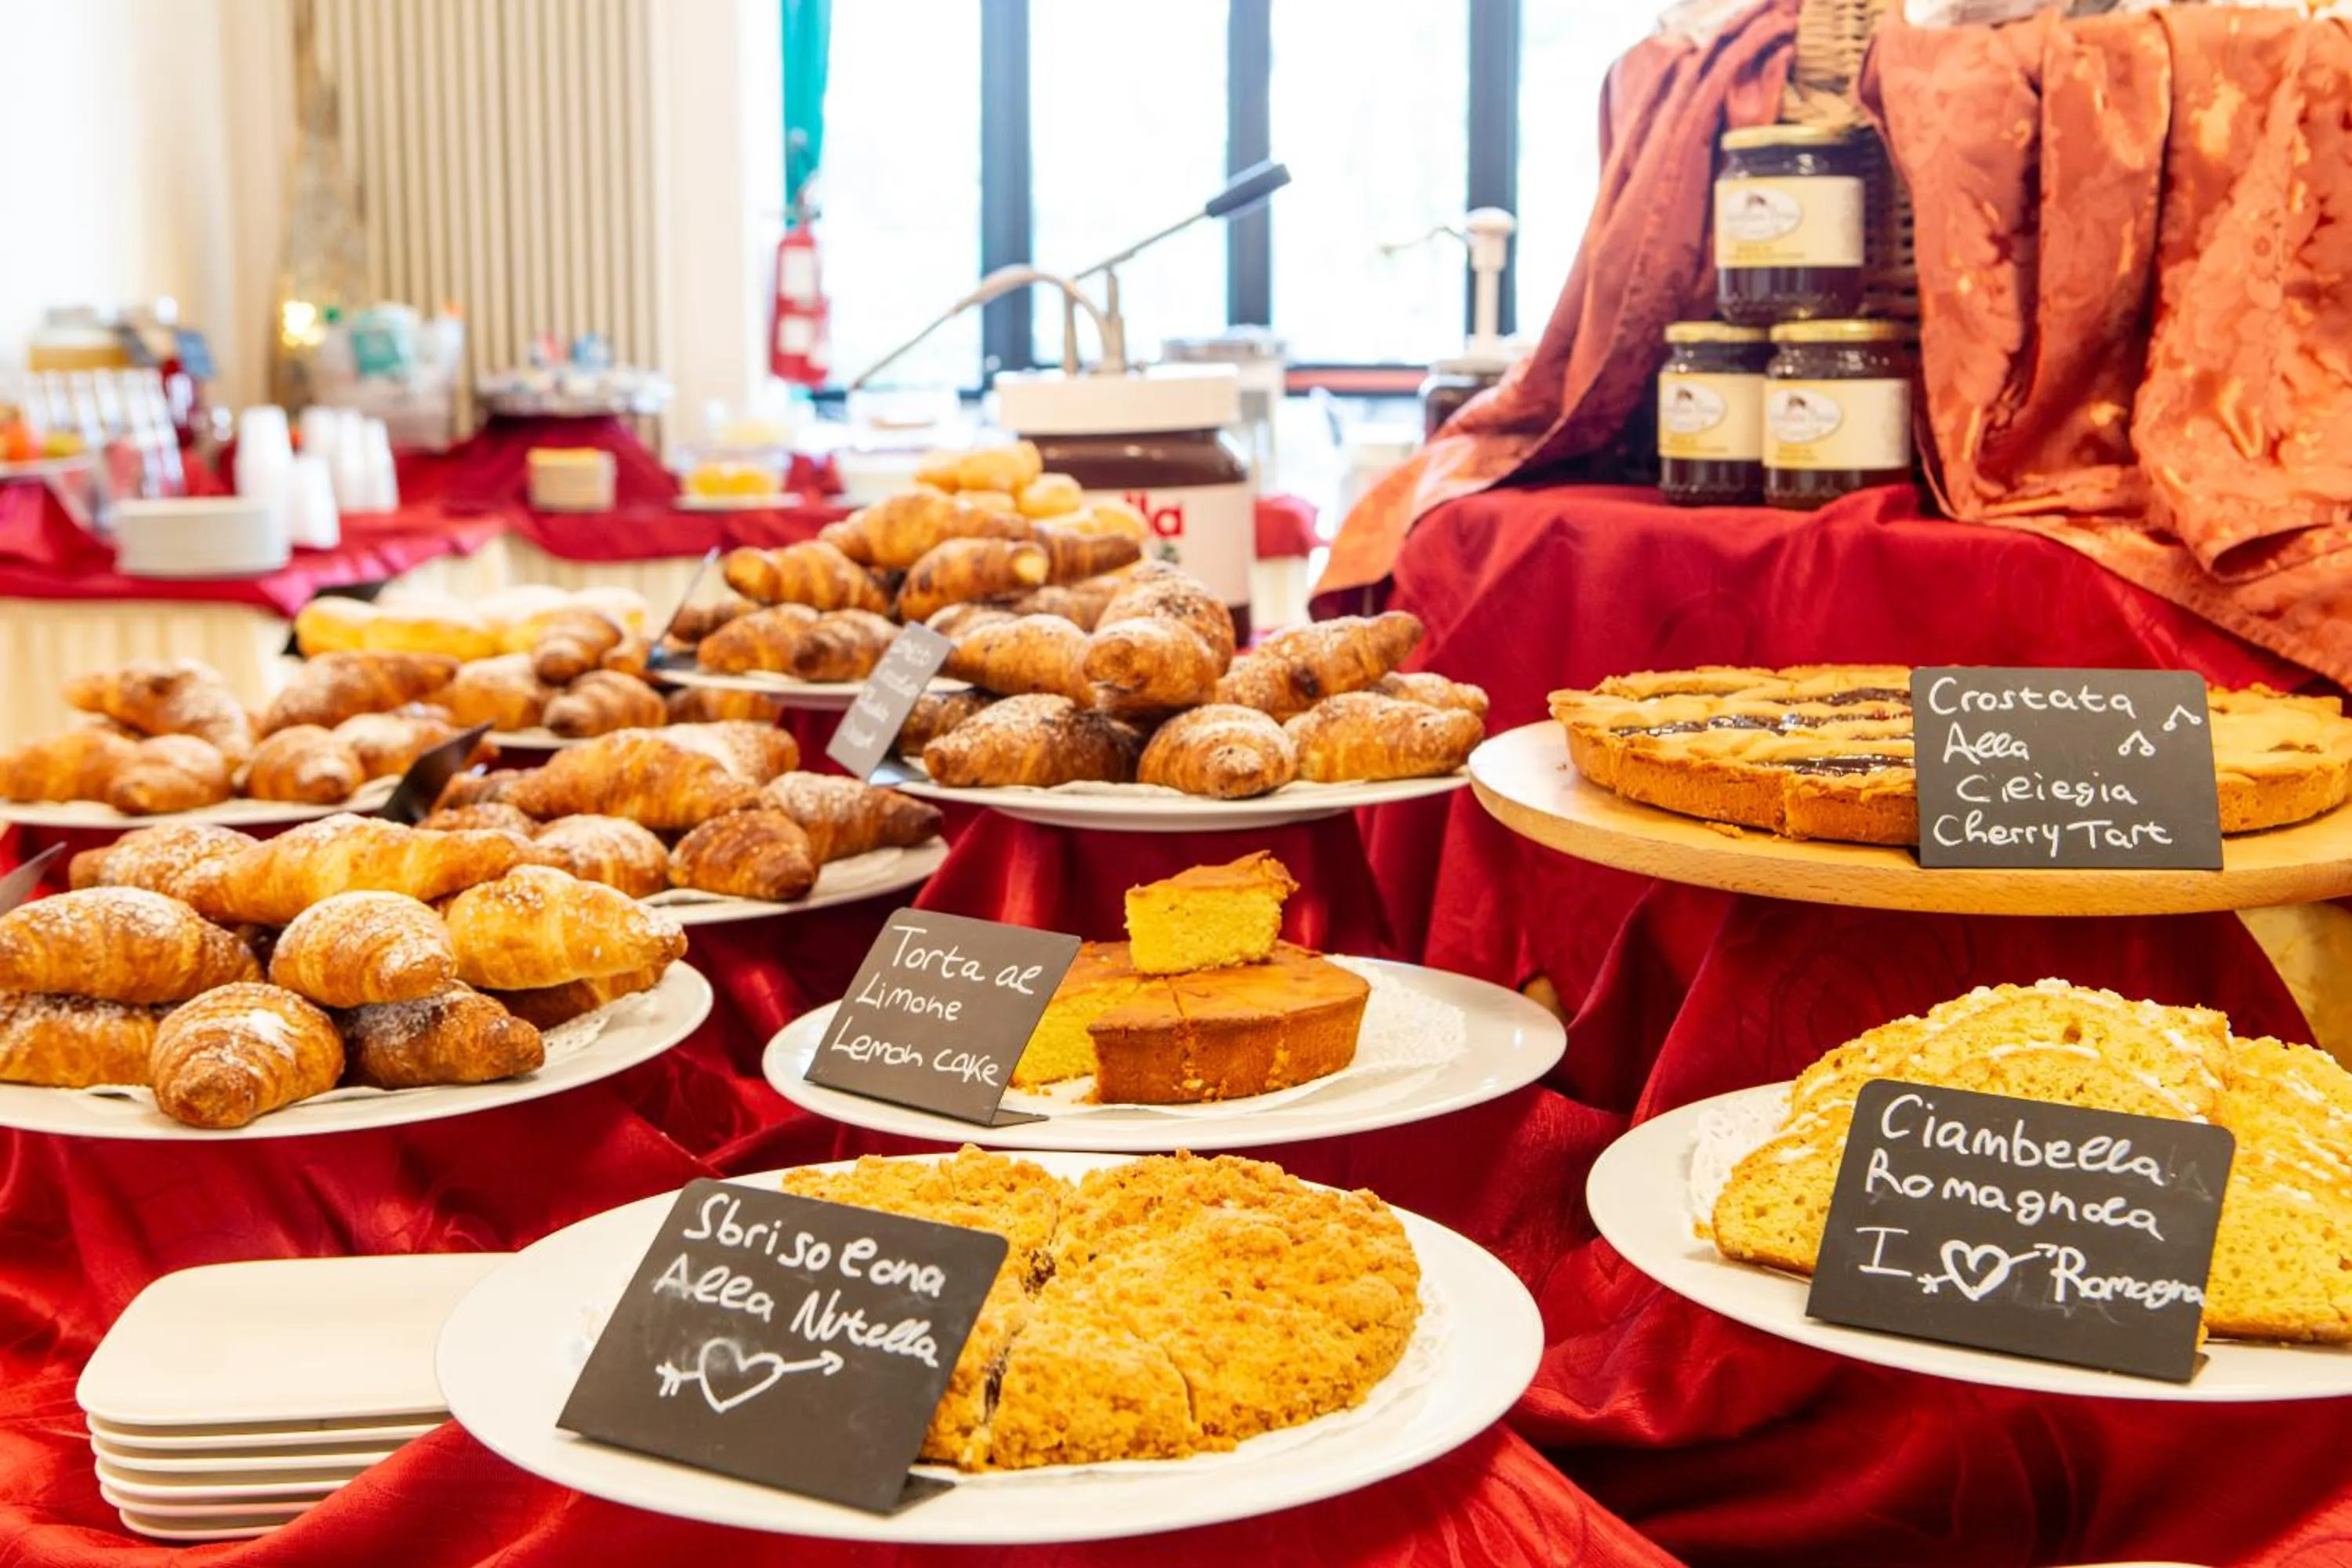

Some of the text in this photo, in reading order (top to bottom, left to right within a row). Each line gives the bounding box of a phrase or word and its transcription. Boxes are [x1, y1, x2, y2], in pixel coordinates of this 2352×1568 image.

[1928, 676, 2137, 720] Crostata
[1942, 720, 2031, 766] Alla
[1933, 809, 2173, 858] Cherry Tart
[892, 925, 985, 982] Torta
[855, 971, 963, 1022] Limone
[830, 1015, 1000, 1087] Lemon cake
[1881, 1094, 2166, 1187] Ciambella
[1865, 1148, 2166, 1242] Romagnola
[1856, 1226, 2206, 1310] I Romagna
[652, 1252, 939, 1369] Alla Nutella
